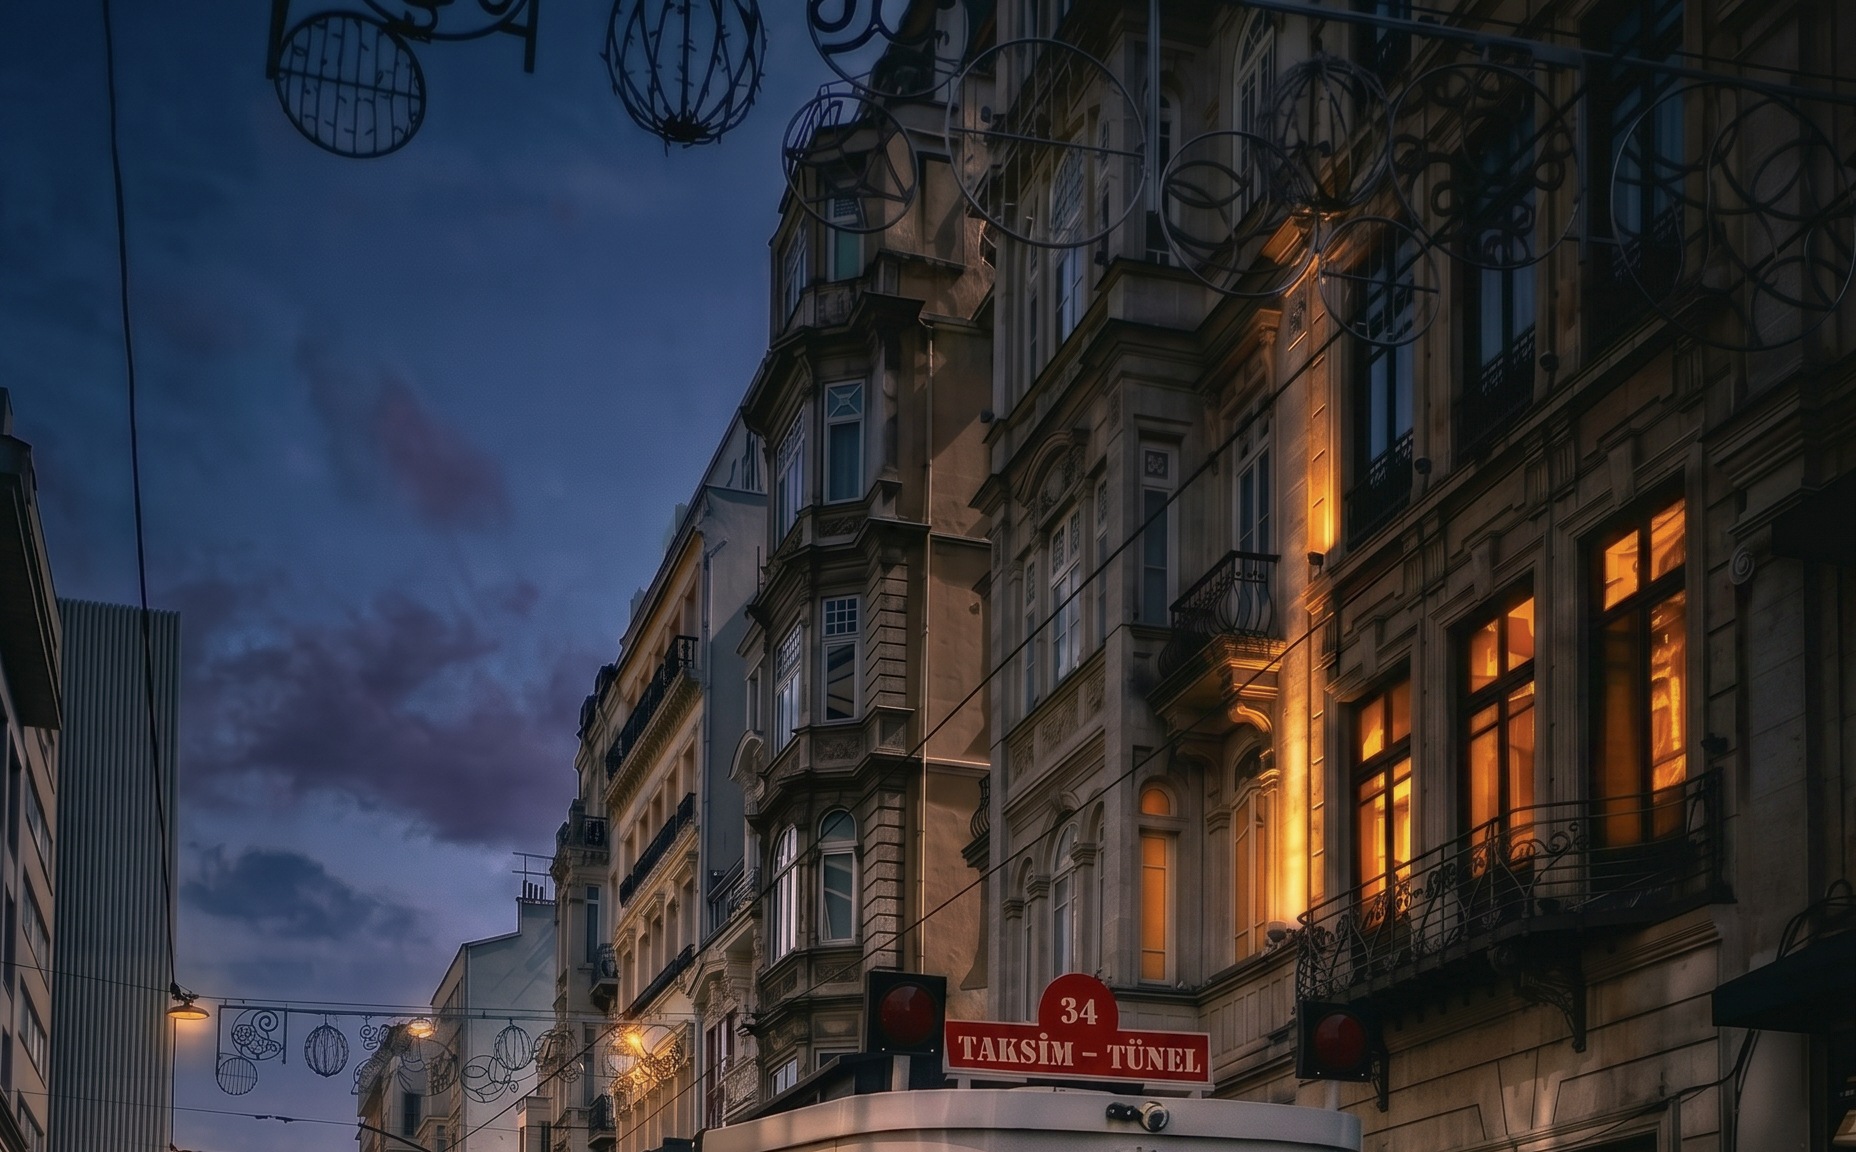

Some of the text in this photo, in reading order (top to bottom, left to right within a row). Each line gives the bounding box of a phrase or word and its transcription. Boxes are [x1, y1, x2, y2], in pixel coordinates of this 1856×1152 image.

[1060, 997, 1098, 1025] 34
[958, 1032, 1074, 1067] TAKSİM
[1107, 1038, 1201, 1073] TÜNEL
